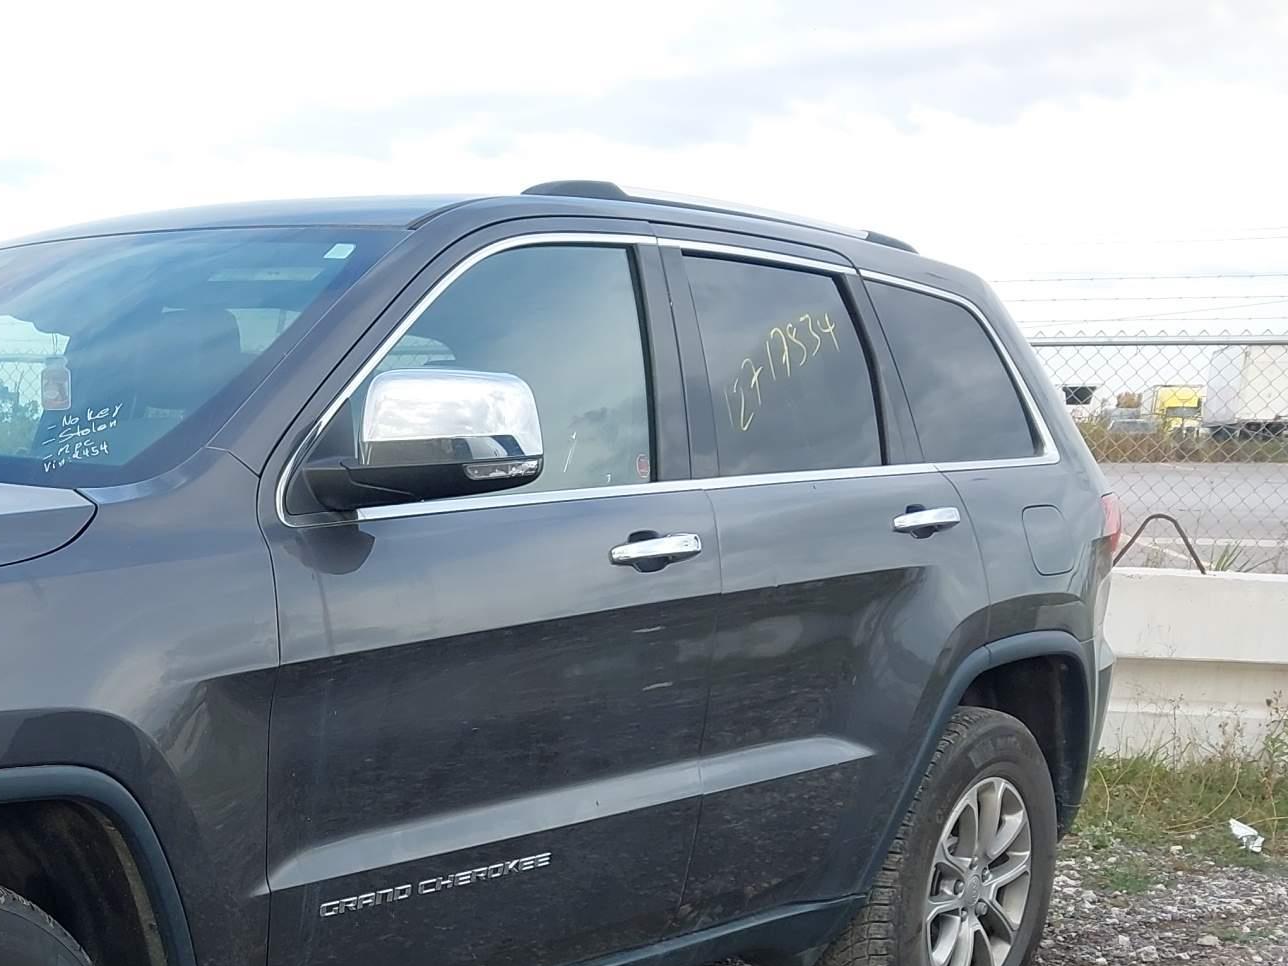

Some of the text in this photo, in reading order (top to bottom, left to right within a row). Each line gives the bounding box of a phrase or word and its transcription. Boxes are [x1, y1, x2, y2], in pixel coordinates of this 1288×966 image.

[62, 415, 80, 427] No
[319, 852, 552, 917] GRAND CHEROKEE
